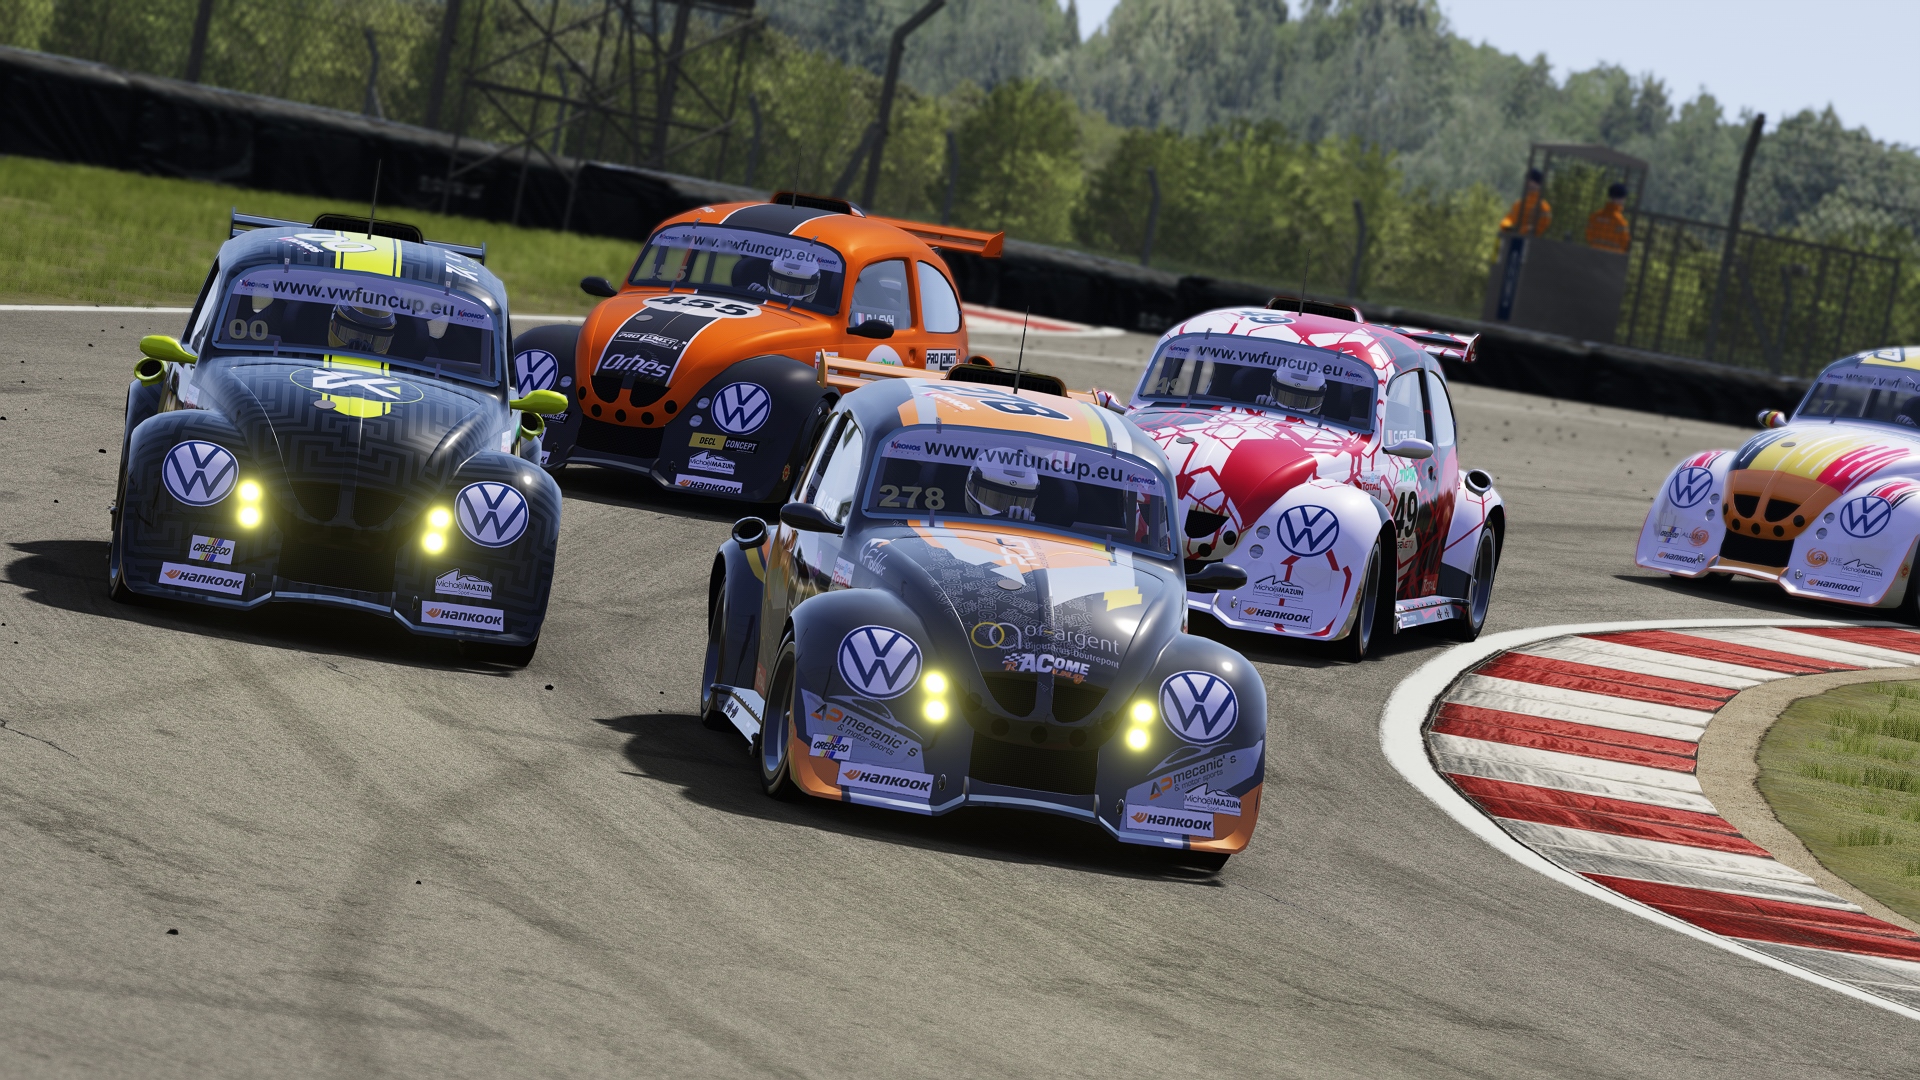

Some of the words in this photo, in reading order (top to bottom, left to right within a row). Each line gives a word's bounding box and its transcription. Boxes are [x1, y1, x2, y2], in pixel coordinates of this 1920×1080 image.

[273, 279, 455, 317] www.vwfuncup.eu
[648, 296, 755, 316] 455
[457, 309, 486, 321] KRONOS
[228, 318, 269, 341] 00
[926, 353, 939, 364] PRO
[699, 436, 717, 446] DECL
[725, 439, 758, 451] CONCEPT
[890, 440, 921, 452] KRONOS
[924, 441, 1123, 482] www.vwfuncup.eu
[1126, 473, 1156, 486] KRONOS
[1361, 481, 1381, 491] TOTAL
[879, 484, 945, 510] 278
[1395, 491, 1418, 538] 49
[192, 543, 231, 557] CREDECO
[813, 740, 850, 753] CREDECO
[844, 728, 869, 743] motor
[869, 740, 895, 757] sports
[1202, 769, 1224, 783] sports
